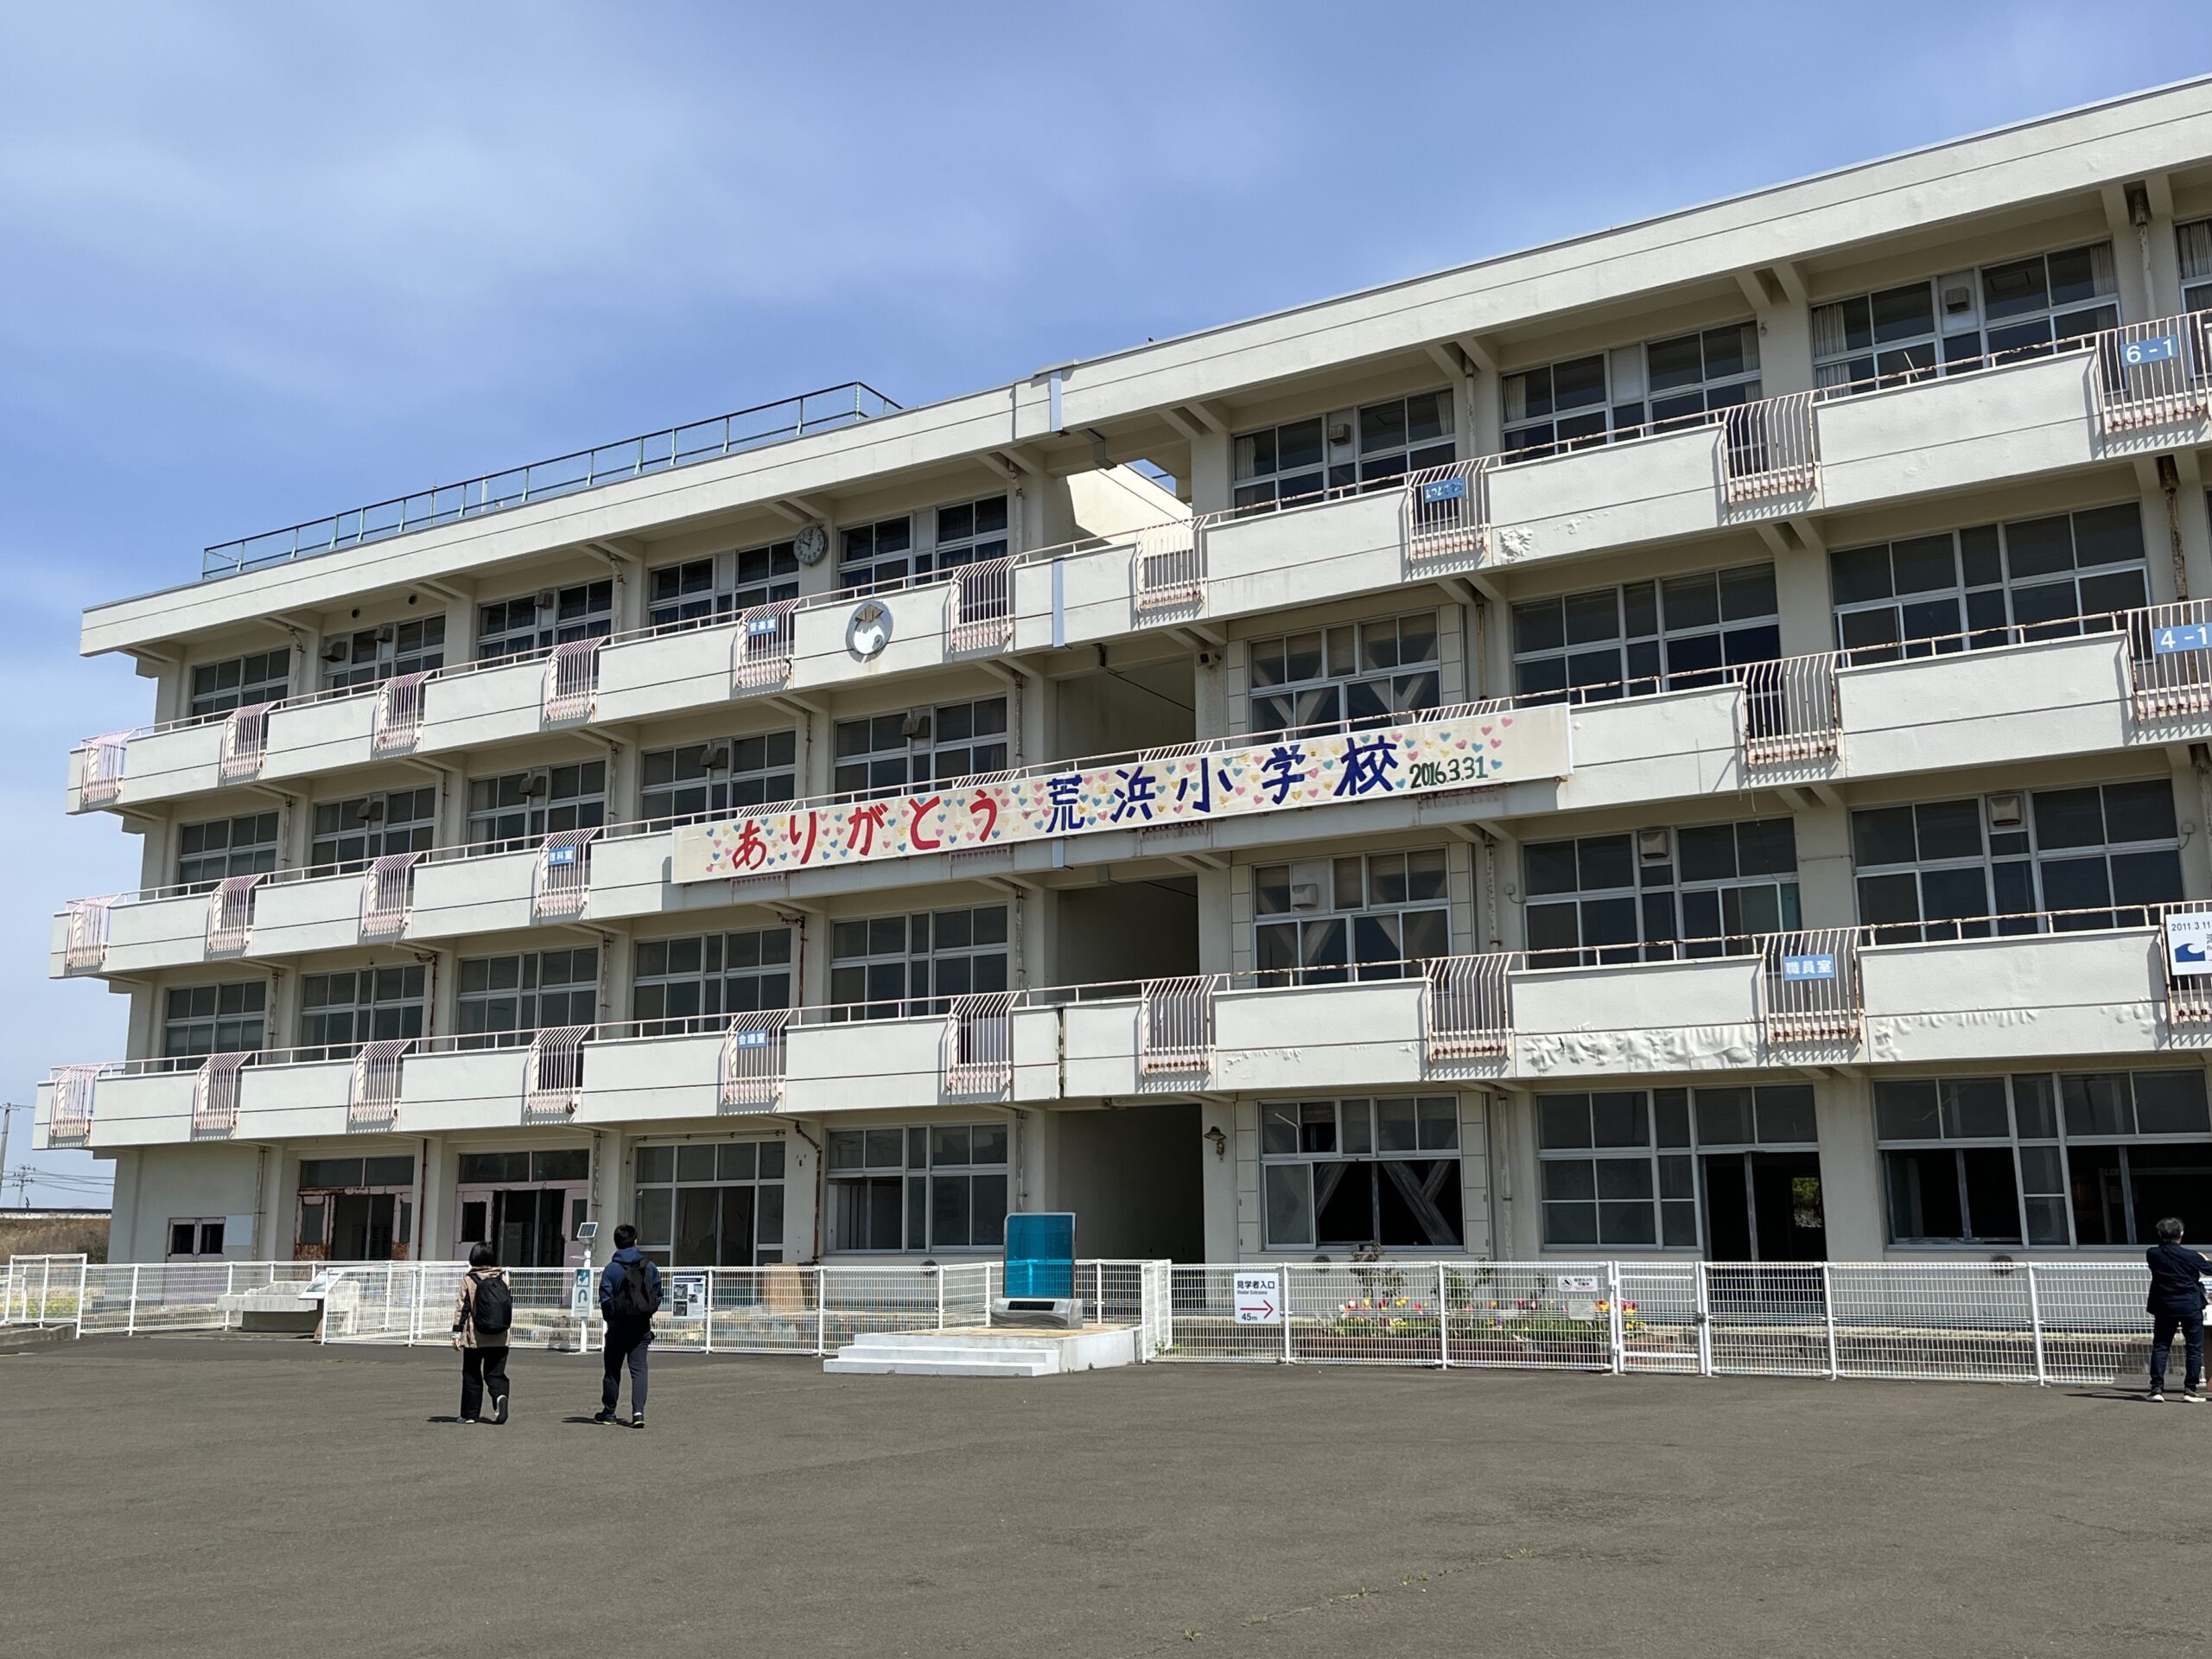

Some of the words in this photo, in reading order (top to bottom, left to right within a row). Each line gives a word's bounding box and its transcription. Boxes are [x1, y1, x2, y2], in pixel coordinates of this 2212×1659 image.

[732, 789, 998, 870] ありがとう
[1046, 735, 1398, 833] 荒浜小学校
[1409, 756, 1489, 789] 2016.3.31
[1785, 959, 1833, 975] 職員室
[738, 1033, 766, 1046] 会議室
[1236, 1281, 1275, 1289] 見学者入口
